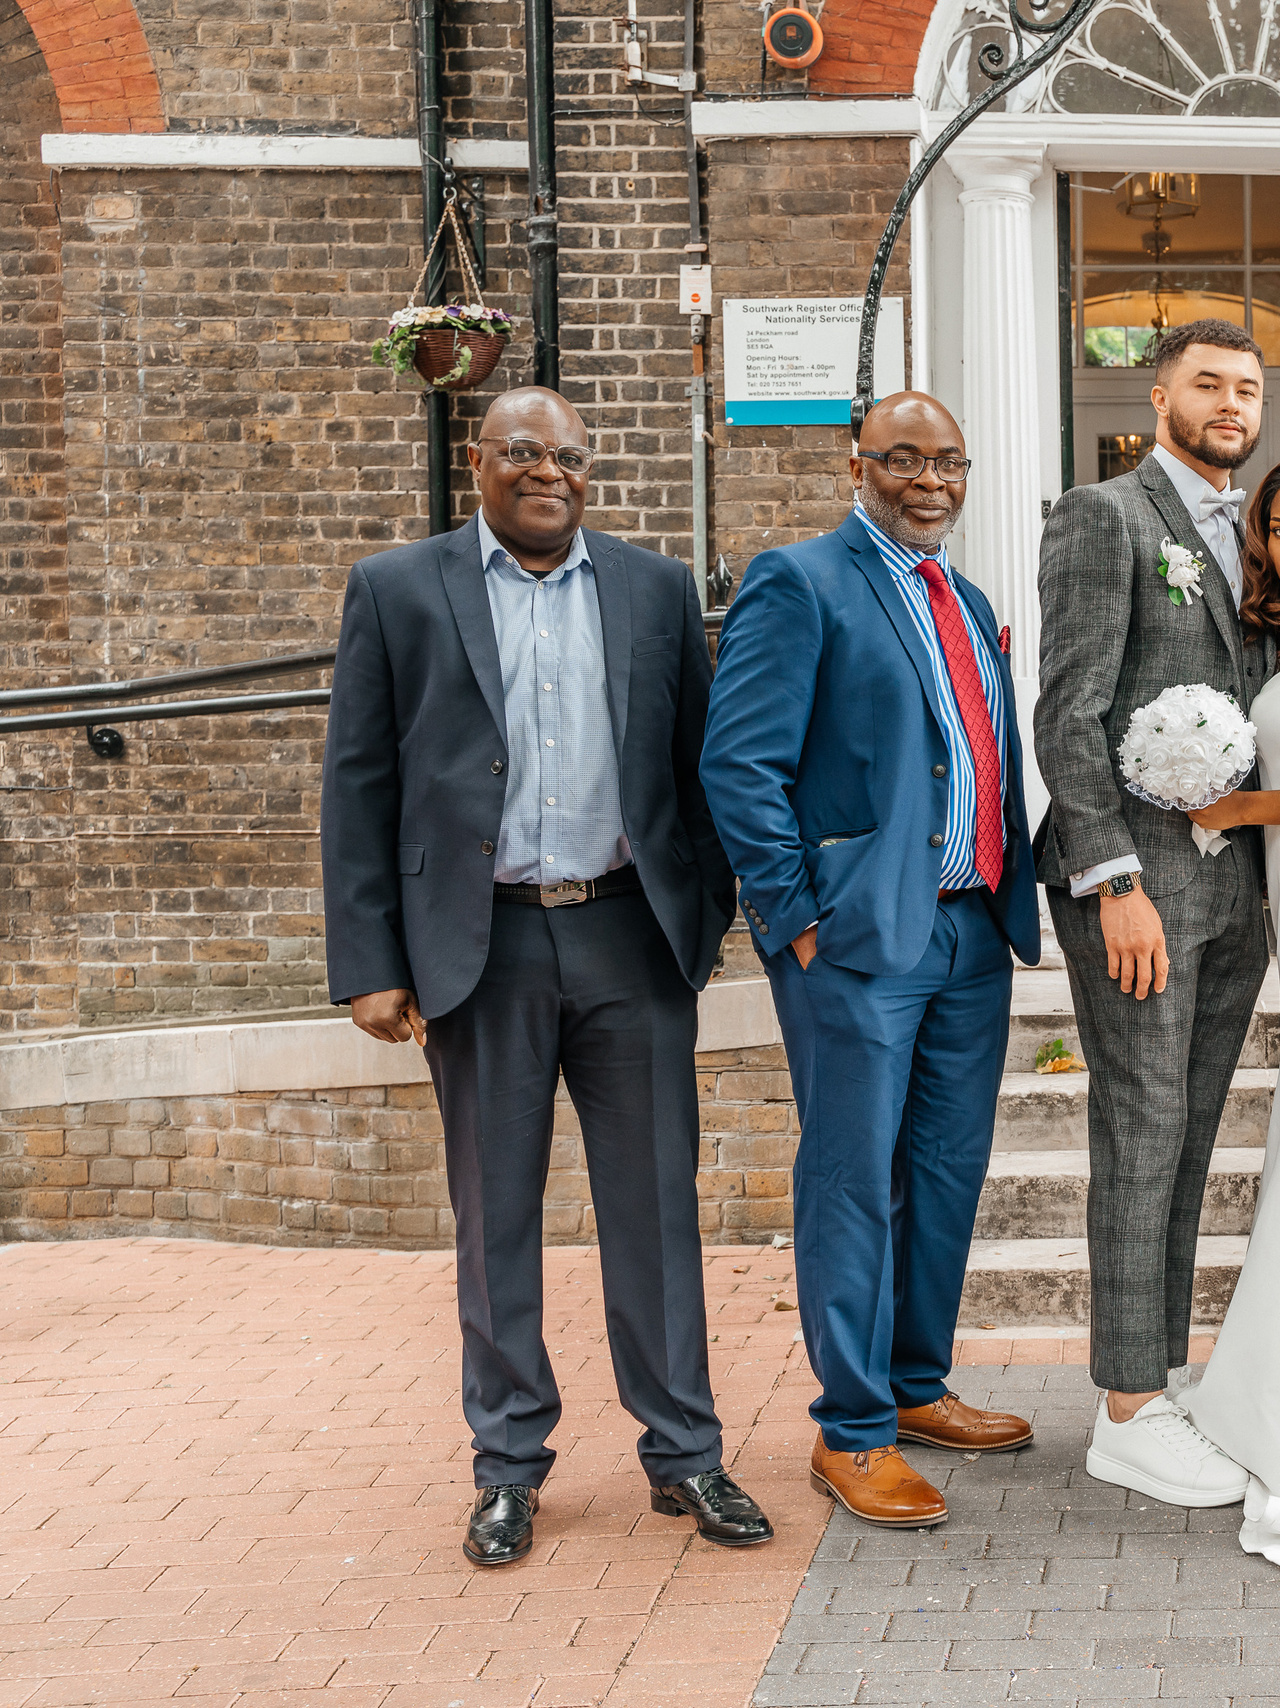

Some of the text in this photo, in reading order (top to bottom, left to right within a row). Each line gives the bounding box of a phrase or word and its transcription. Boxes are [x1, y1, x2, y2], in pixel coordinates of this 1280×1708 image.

[742, 304, 794, 313] Southwark
[796, 304, 836, 314] Register
[839, 304, 862, 312] Offic
[765, 314, 860, 324] Nationality Services
